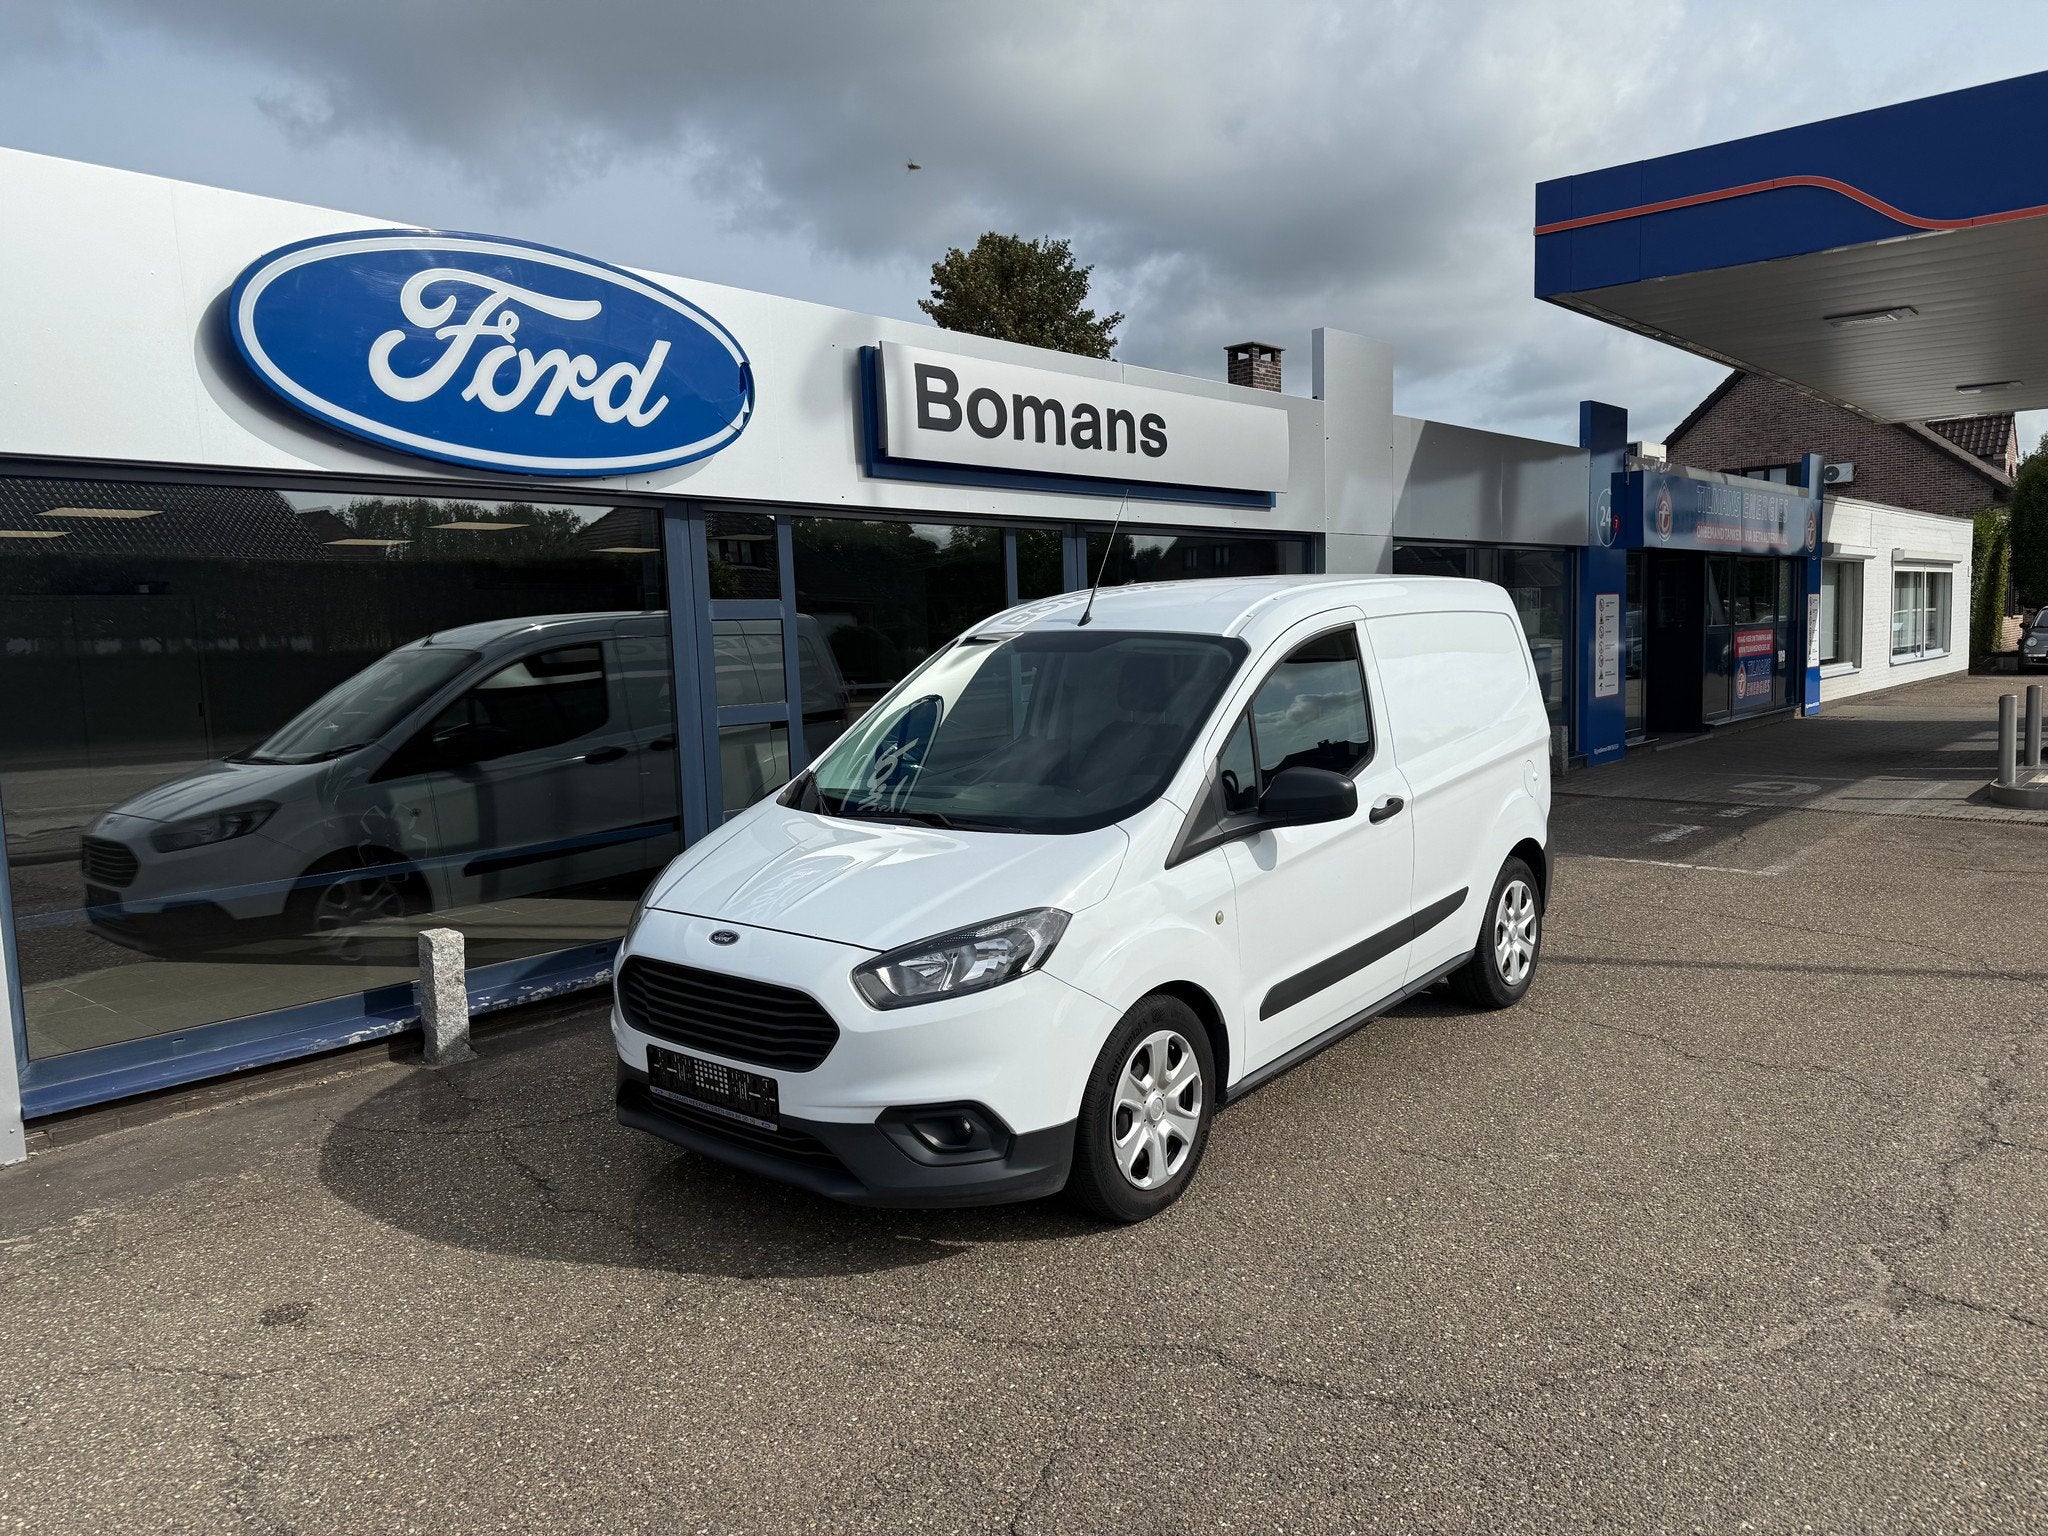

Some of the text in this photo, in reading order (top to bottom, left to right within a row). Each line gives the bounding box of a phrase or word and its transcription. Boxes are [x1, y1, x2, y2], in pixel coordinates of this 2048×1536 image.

[367, 268, 671, 427] Ford
[914, 362, 1168, 458] Bomans
[1600, 505, 1611, 527] 24
[1696, 485, 1789, 524] TILMANS ENERGIES
